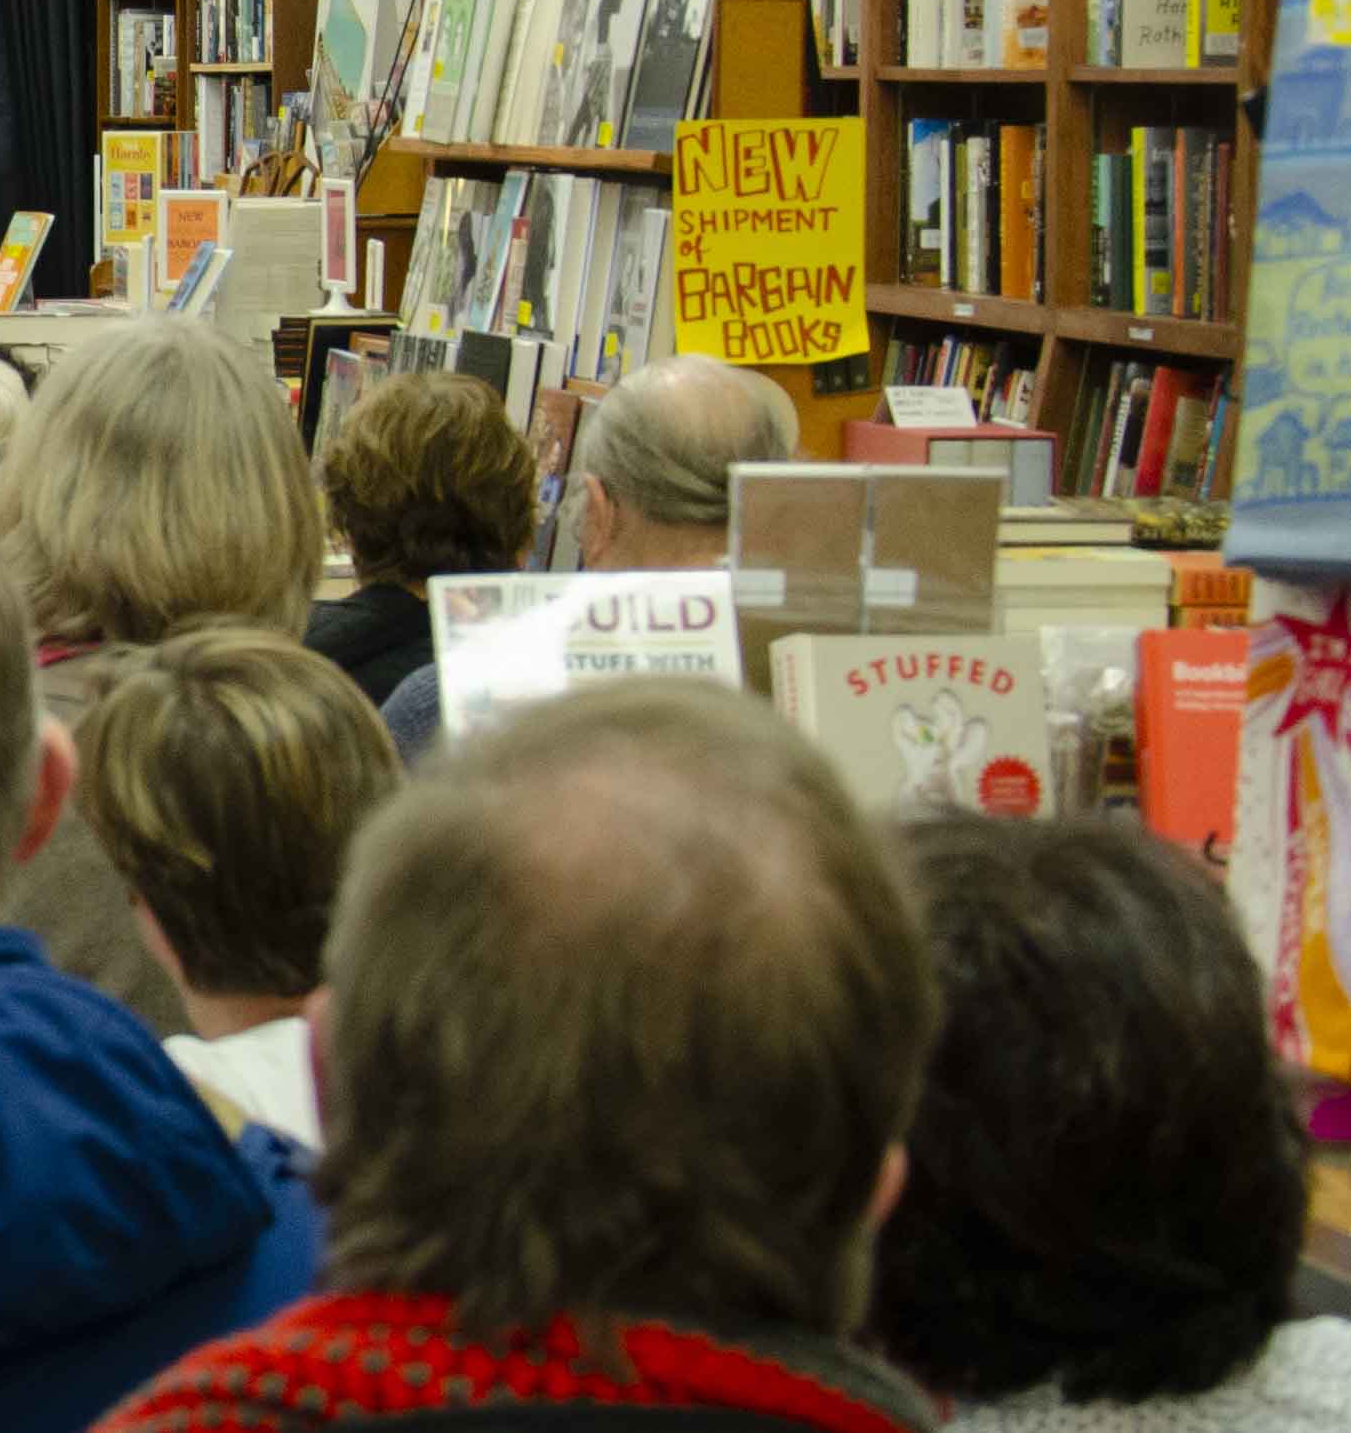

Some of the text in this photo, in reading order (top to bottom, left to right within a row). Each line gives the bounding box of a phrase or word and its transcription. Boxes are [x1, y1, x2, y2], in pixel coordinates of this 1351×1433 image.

[677, 124, 840, 203] NEW
[679, 207, 839, 235] SHIPMENT
[679, 234, 712, 265] of
[678, 261, 857, 324] BARGAIN
[722, 314, 843, 361] BOOKS
[567, 593, 716, 634] UILD
[564, 652, 715, 672] STUFF WITH
[845, 652, 1016, 698] STUFFED
